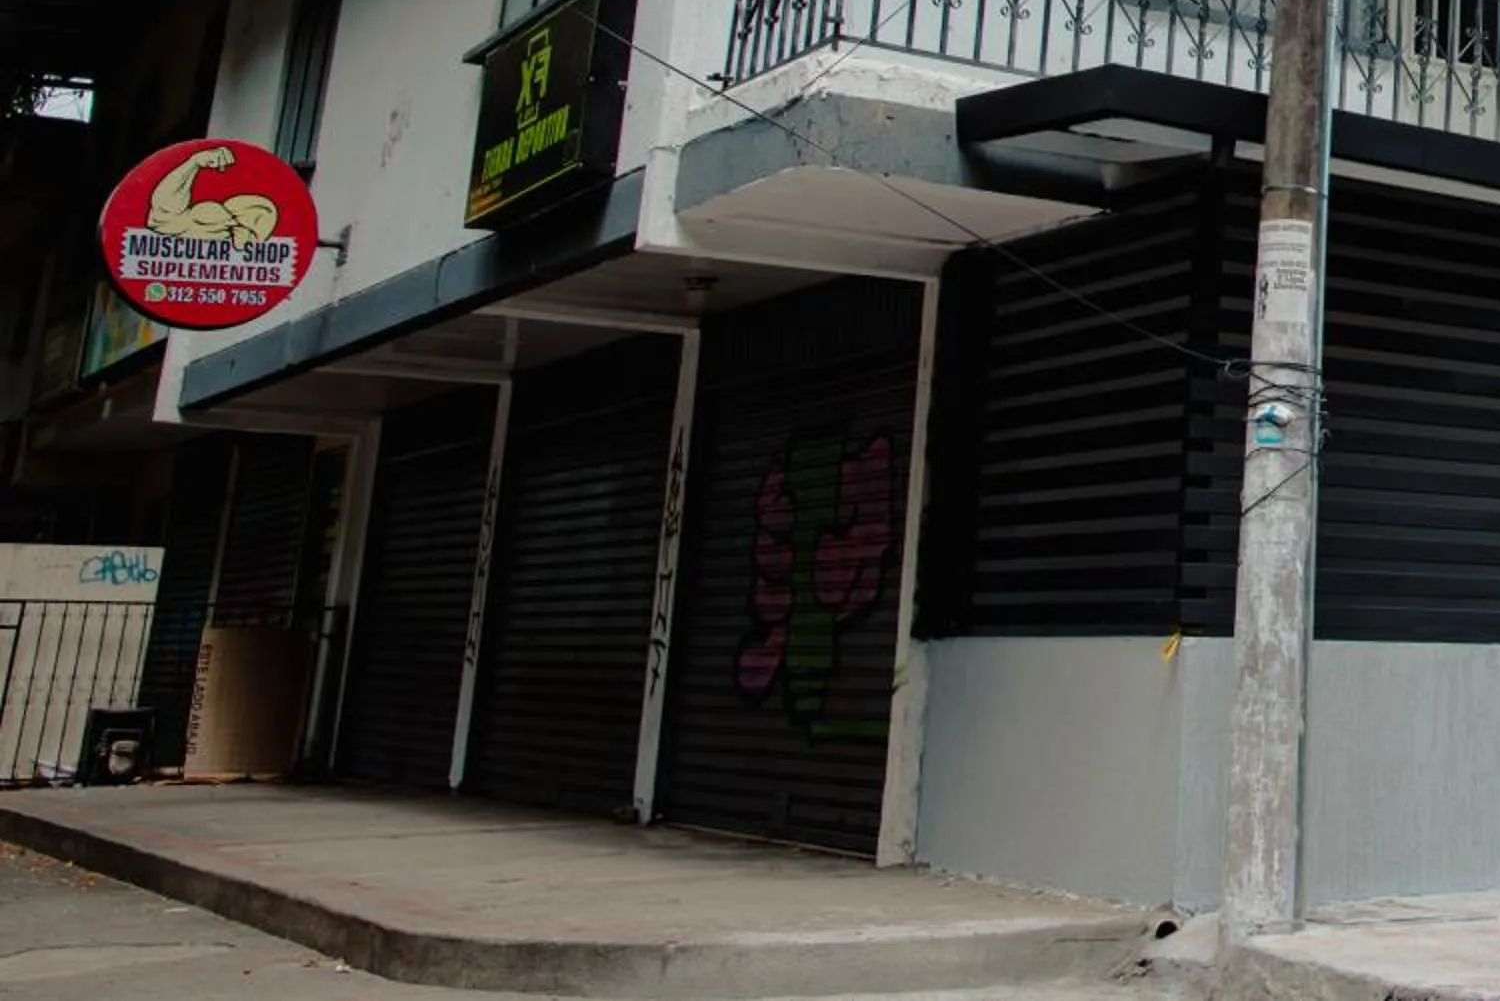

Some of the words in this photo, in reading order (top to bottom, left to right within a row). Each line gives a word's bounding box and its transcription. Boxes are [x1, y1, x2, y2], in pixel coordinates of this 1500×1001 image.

[129, 235, 230, 261] MUSCULAR
[243, 241, 290, 264] SHOP
[137, 261, 281, 283] SUPLEMENTOS
[167, 287, 193, 303] 312
